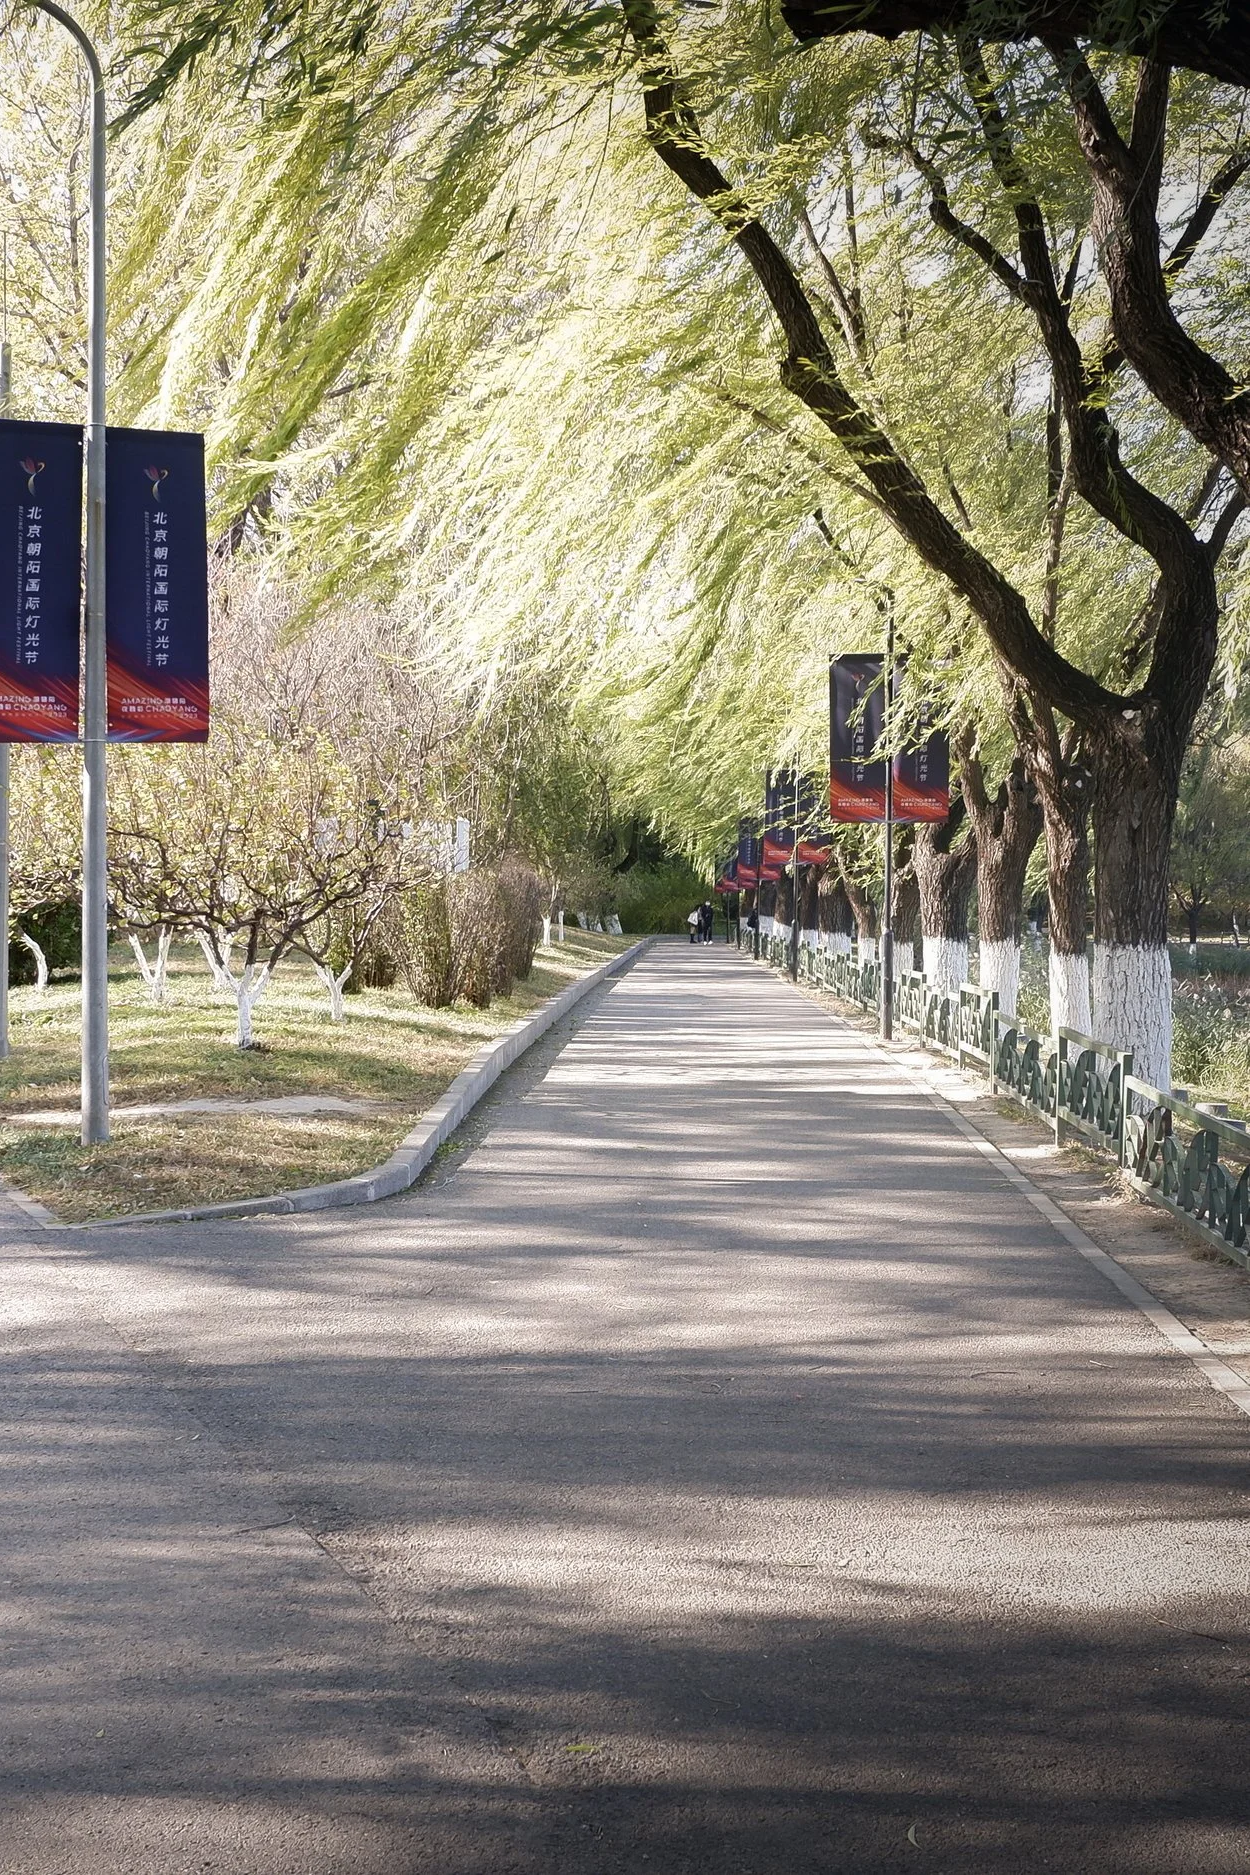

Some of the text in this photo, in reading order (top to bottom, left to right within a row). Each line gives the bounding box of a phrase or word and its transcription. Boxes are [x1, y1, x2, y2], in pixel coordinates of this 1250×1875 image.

[24, 506, 43, 665] 北京朝阳国际灯光节
[152, 512, 170, 667] 北京朝阳国际灯光节
[13, 703, 68, 711] CHAOYANG
[145, 705, 198, 713] CHAOYANG
